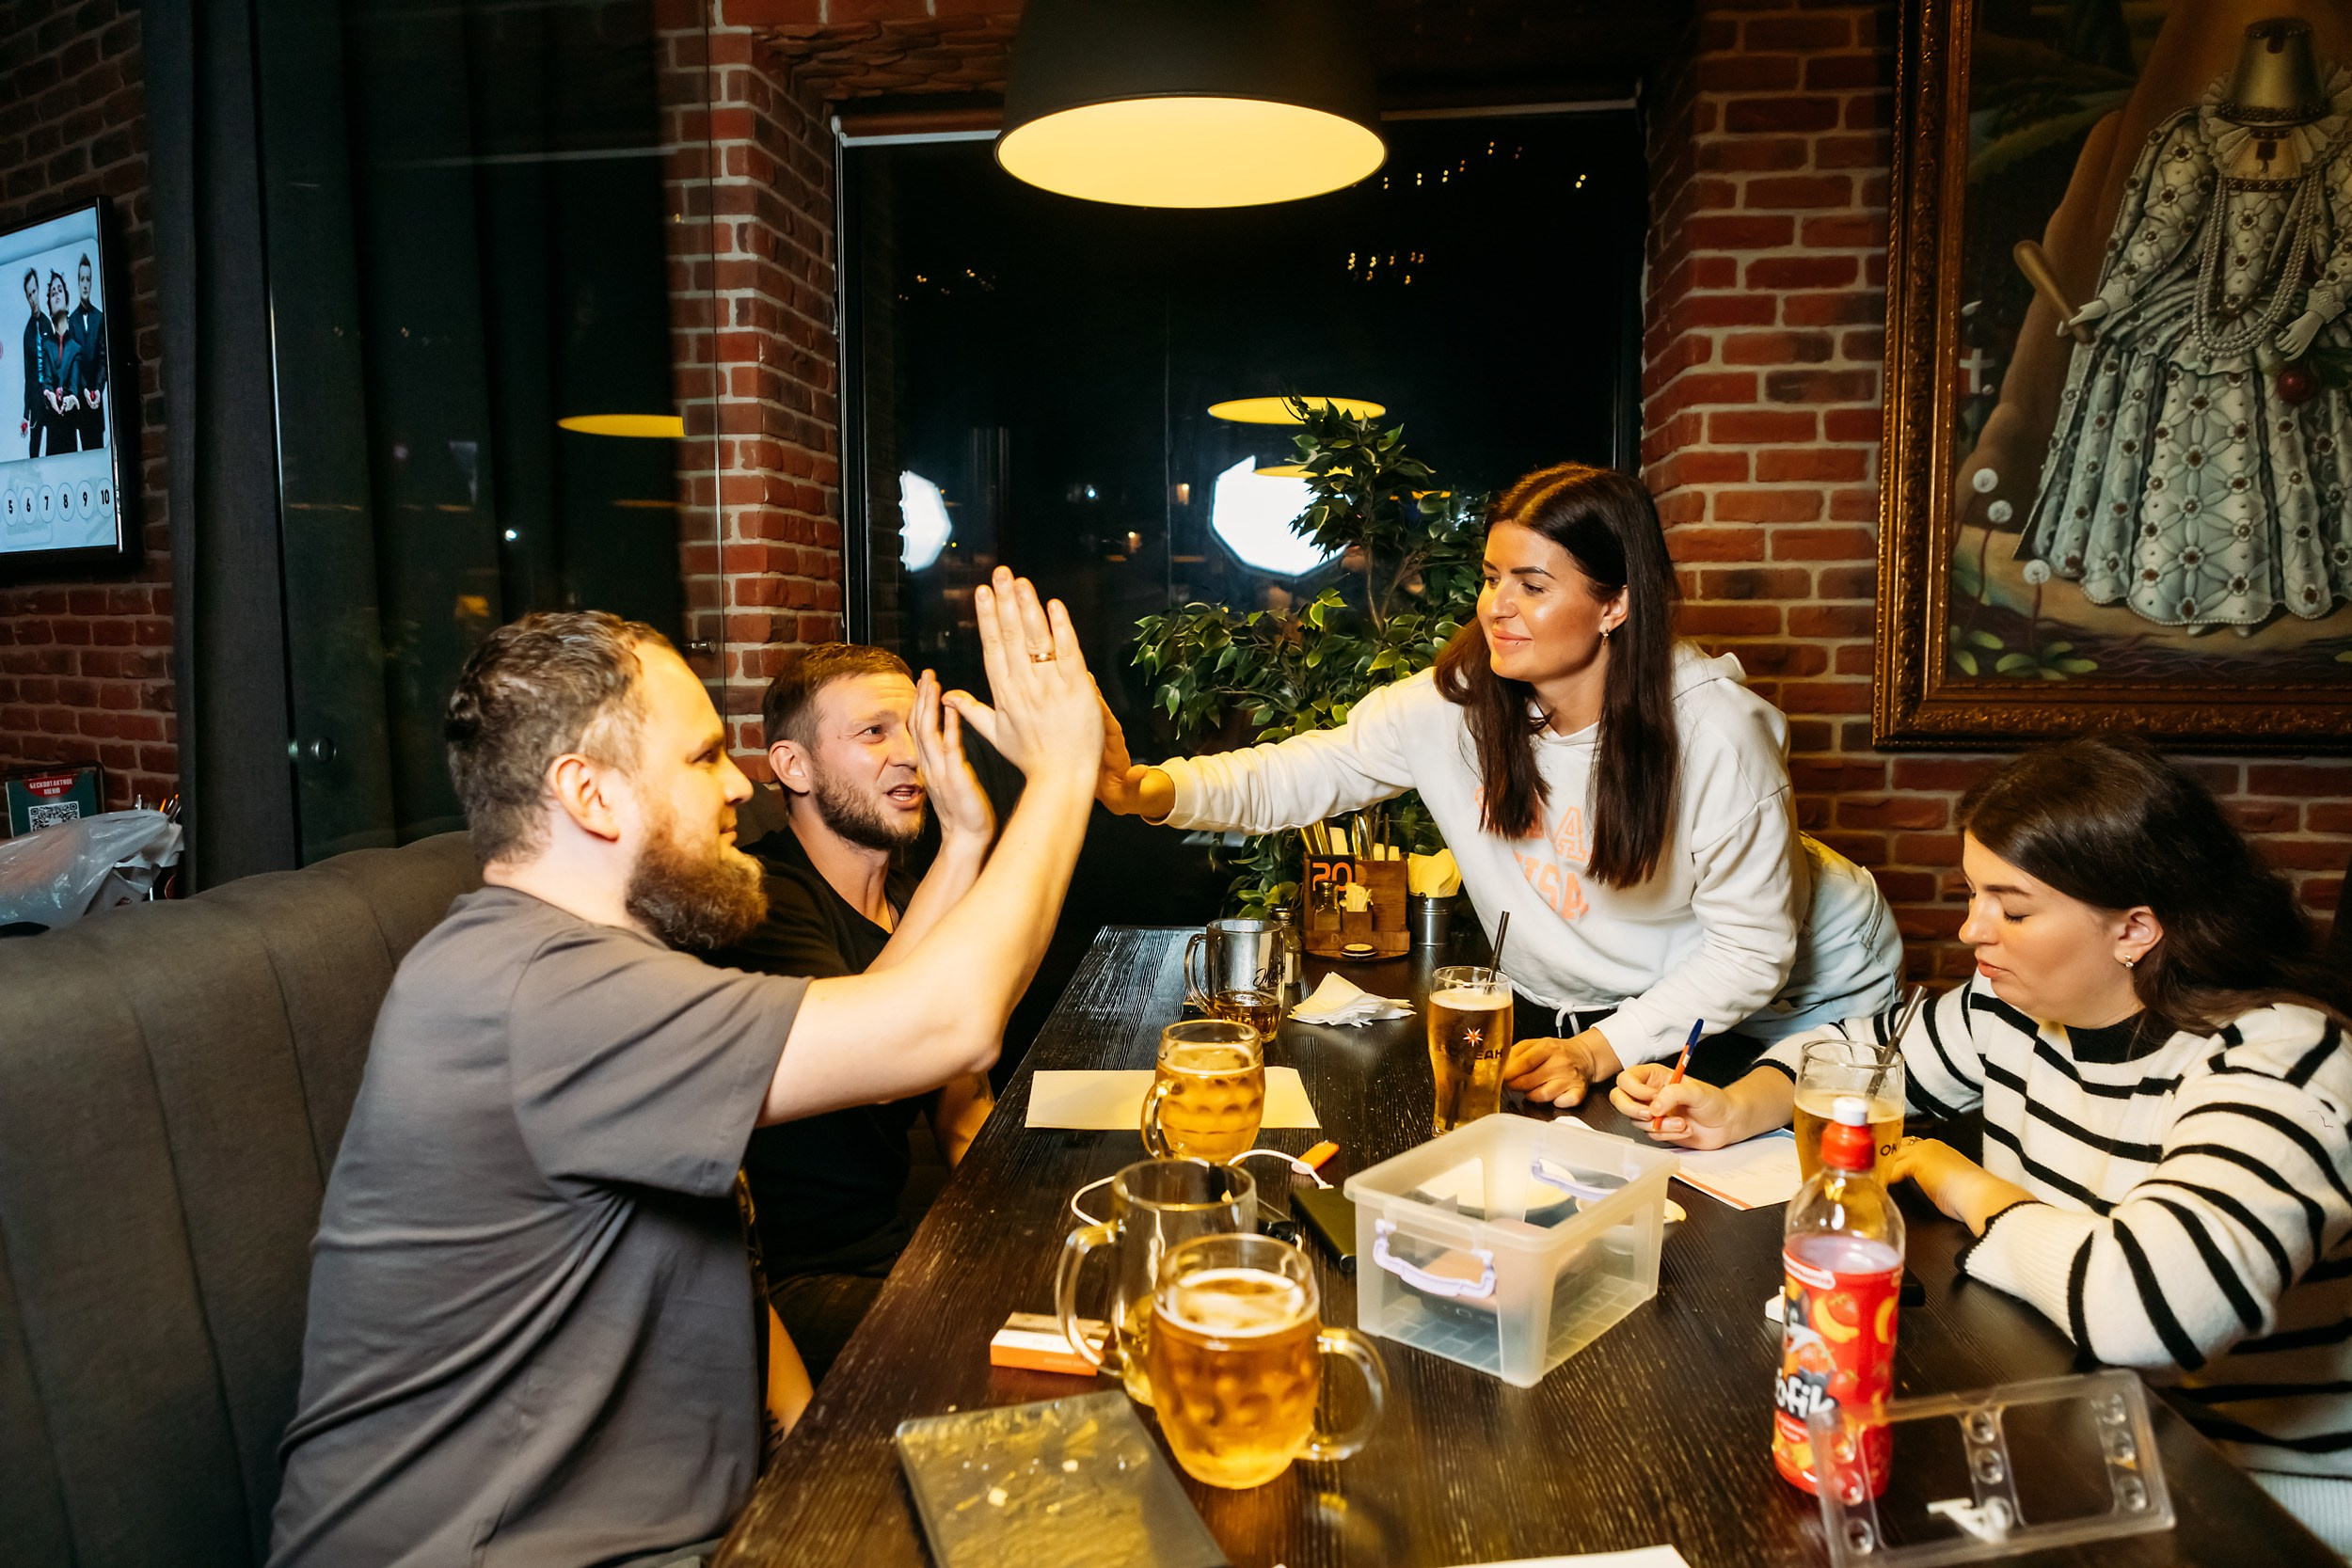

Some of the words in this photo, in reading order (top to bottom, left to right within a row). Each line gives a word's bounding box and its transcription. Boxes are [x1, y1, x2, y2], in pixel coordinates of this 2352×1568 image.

[8, 499, 13, 515] 5
[25, 498, 31, 513] 6
[44, 496, 49, 511] 7
[63, 494, 69, 509] 8
[82, 491, 87, 507] 9
[101, 489, 110, 505] 10
[29, 778, 72, 790] БЕСКОНТАКТНОЕ
[43, 786, 61, 796] МЕНЮ
[1312, 862, 1353, 892] 20
